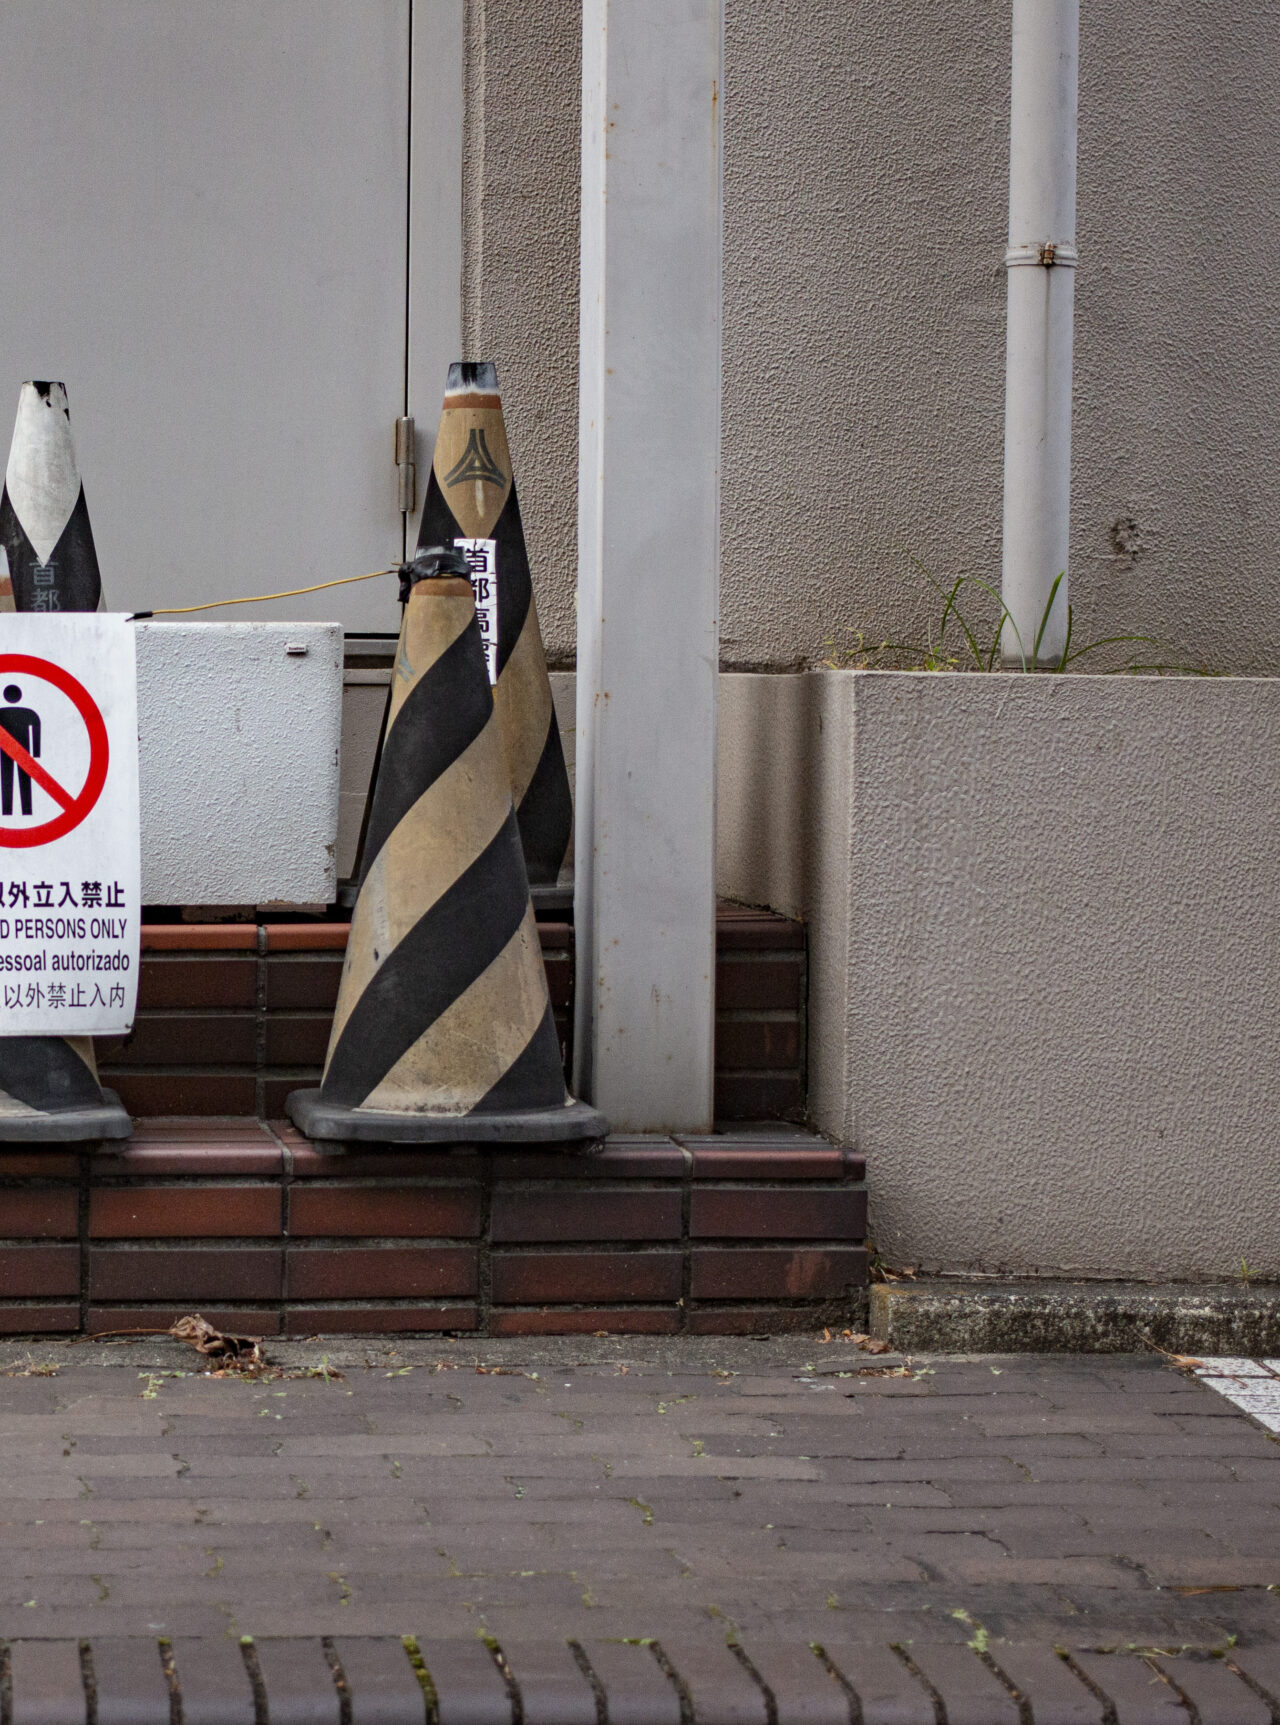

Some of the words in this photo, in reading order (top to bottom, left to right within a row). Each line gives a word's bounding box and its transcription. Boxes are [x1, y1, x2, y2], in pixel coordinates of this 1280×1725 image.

[15, 918, 86, 939] PERSONS
[90, 918, 128, 939] ONLY
[52, 948, 130, 971] autorizado
